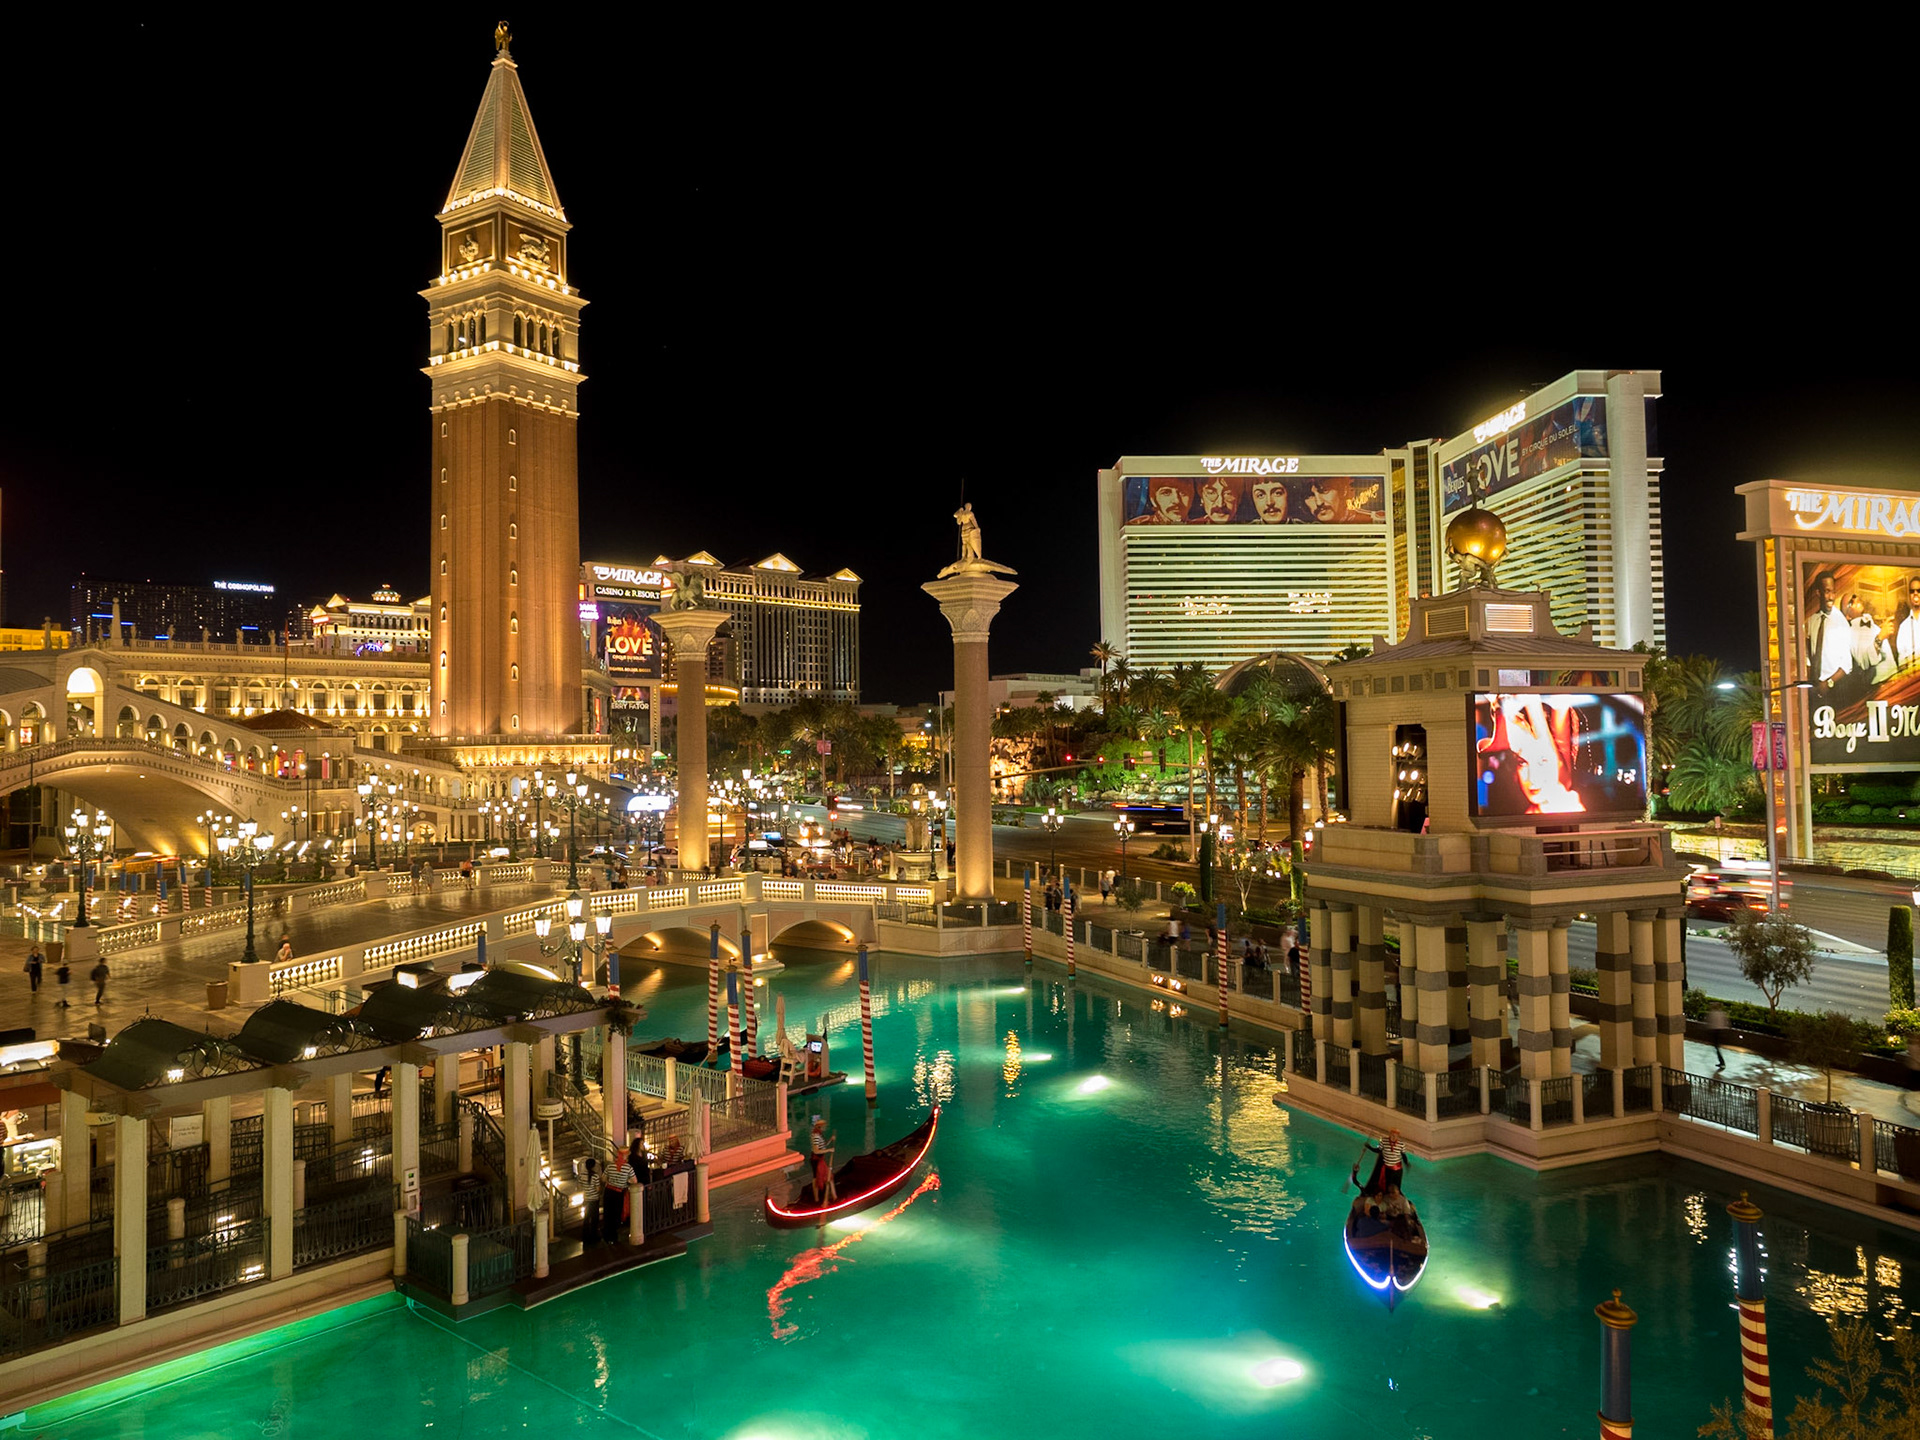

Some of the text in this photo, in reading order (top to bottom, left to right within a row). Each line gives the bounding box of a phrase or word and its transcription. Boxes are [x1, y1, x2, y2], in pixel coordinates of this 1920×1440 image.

[1529, 437, 1549, 452] CIRQUE
[1549, 432, 1558, 444] DU
[1557, 424, 1579, 439] SOLEIL
[1200, 457, 1299, 475] THE MIRAGE
[1786, 491, 1823, 513] THE
[593, 566, 610, 575] THE
[597, 567, 662, 585] MIRAGE
[213, 581, 274, 592] THE COSMOPOLITAN
[595, 587, 661, 600] CASINO & RESORT
[606, 635, 653, 655] LOVE
[1813, 705, 1867, 754] Boyz
[1866, 700, 1890, 743] II
